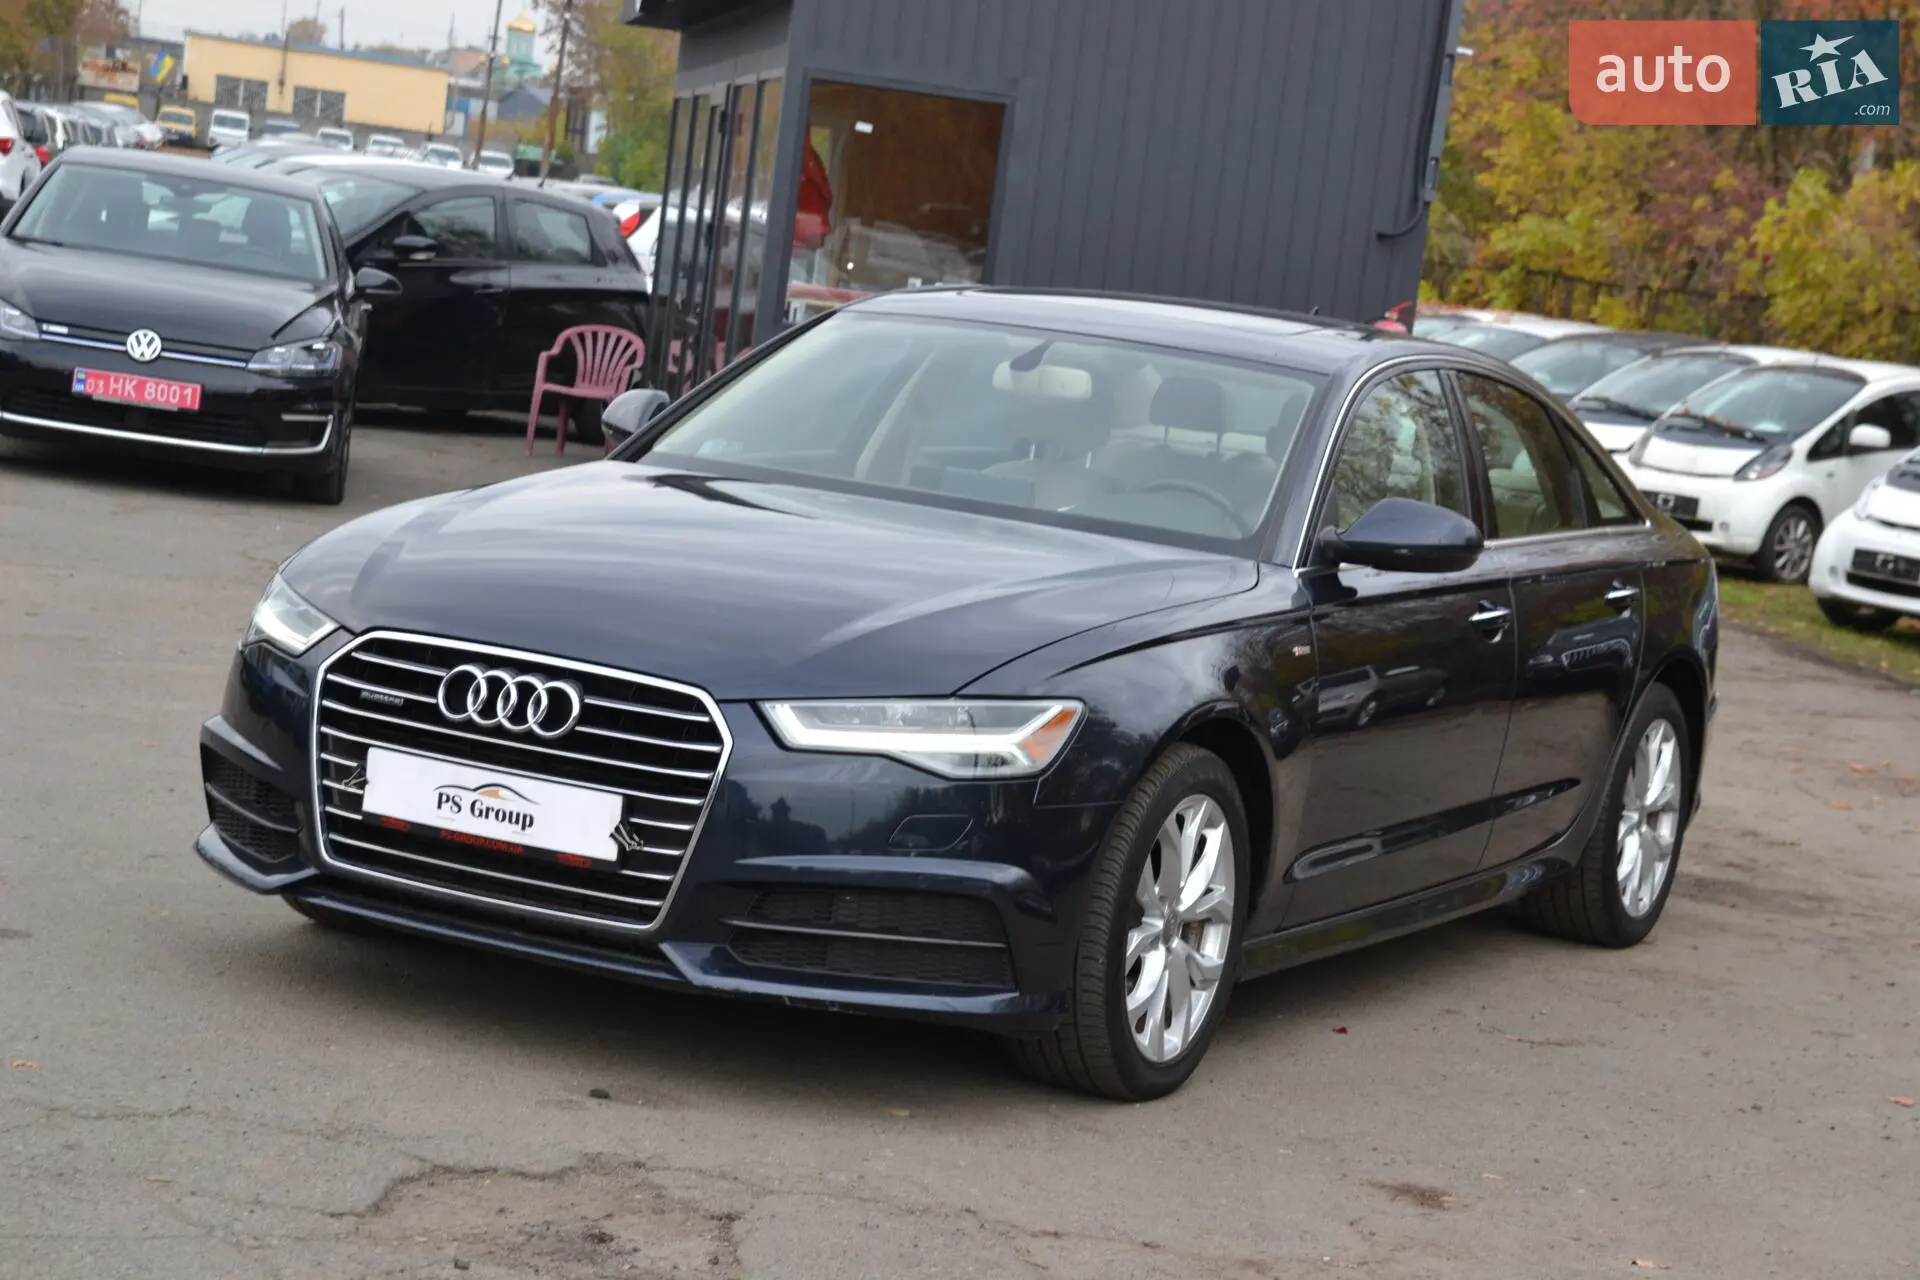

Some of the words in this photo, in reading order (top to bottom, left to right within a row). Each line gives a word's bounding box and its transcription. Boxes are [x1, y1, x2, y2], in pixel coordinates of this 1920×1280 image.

[109, 375, 139, 398] HK
[144, 381, 193, 406] 8001
[437, 791, 463, 814] PS
[470, 798, 534, 831] Group
